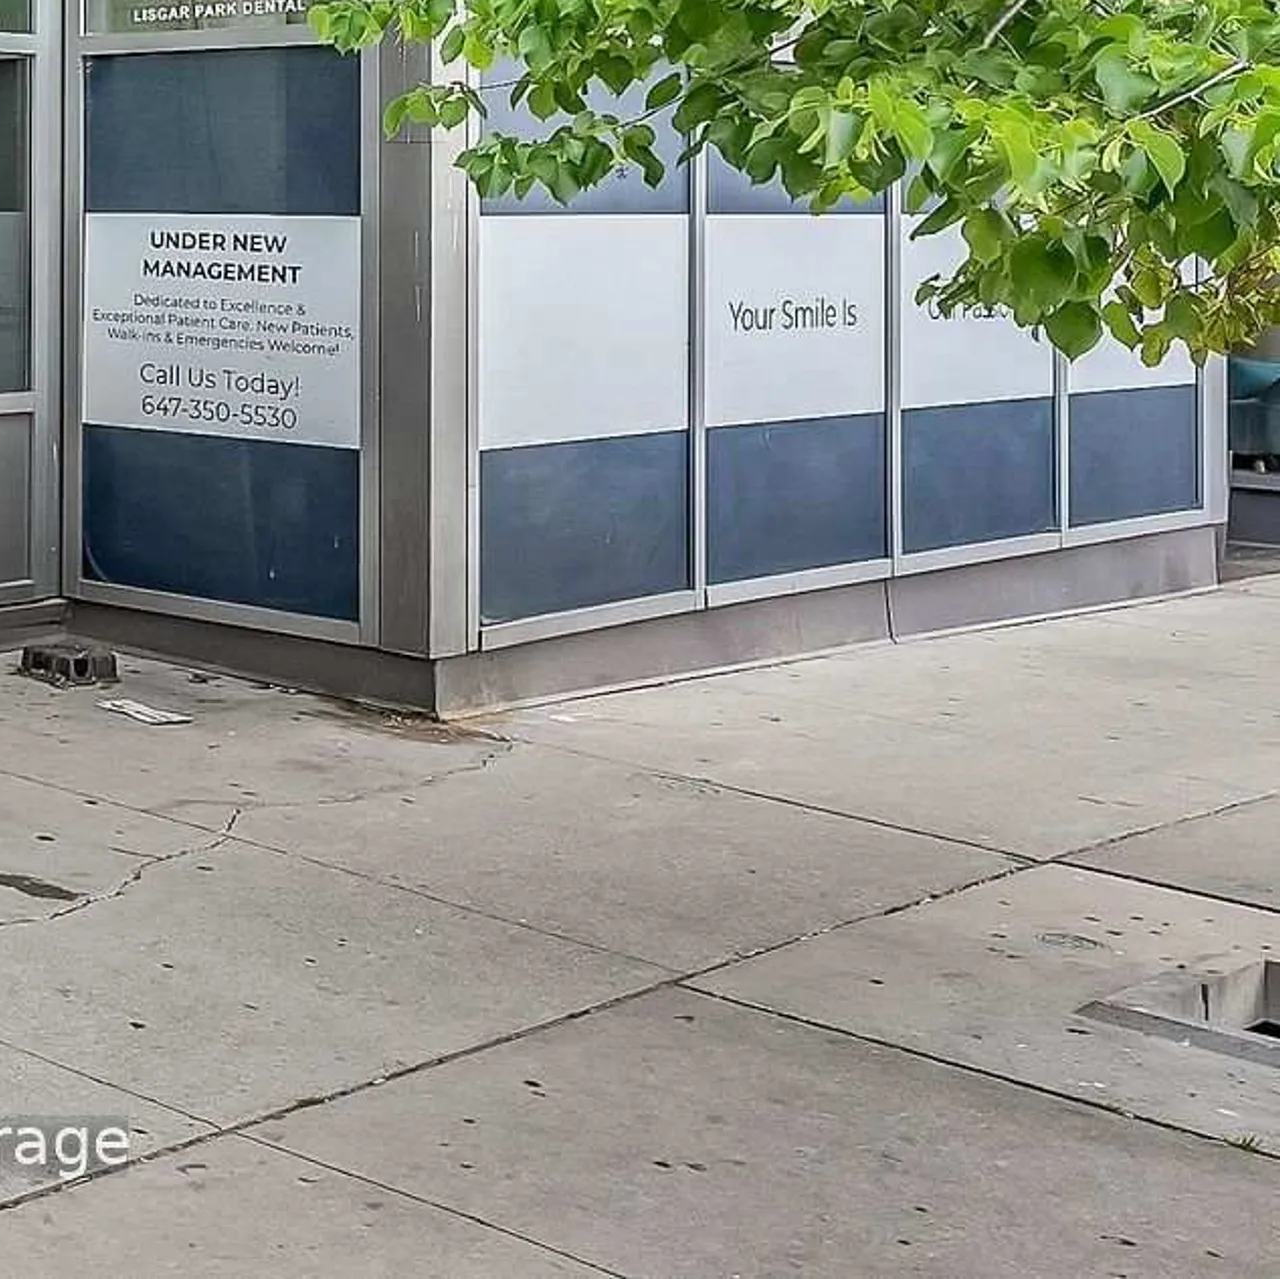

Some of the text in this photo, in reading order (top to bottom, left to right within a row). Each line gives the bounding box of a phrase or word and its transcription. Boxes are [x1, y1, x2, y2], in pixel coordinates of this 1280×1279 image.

[133, 4, 190, 22] LISGAR
[194, 1, 237, 18] PARK
[150, 231, 287, 253] UNDER NEW
[143, 260, 302, 283] MANAGEMENT
[133, 293, 307, 316] Dedicated to Excellence &
[728, 297, 858, 331] Your Smile Is
[92, 308, 165, 325] Exceptional
[168, 312, 215, 328] Patient
[257, 320, 288, 334] New
[107, 327, 340, 357] Walk-ins & Emergencies Welcome!
[140, 363, 301, 401] Call Us Today!
[141, 395, 297, 429] 647-350-5530
